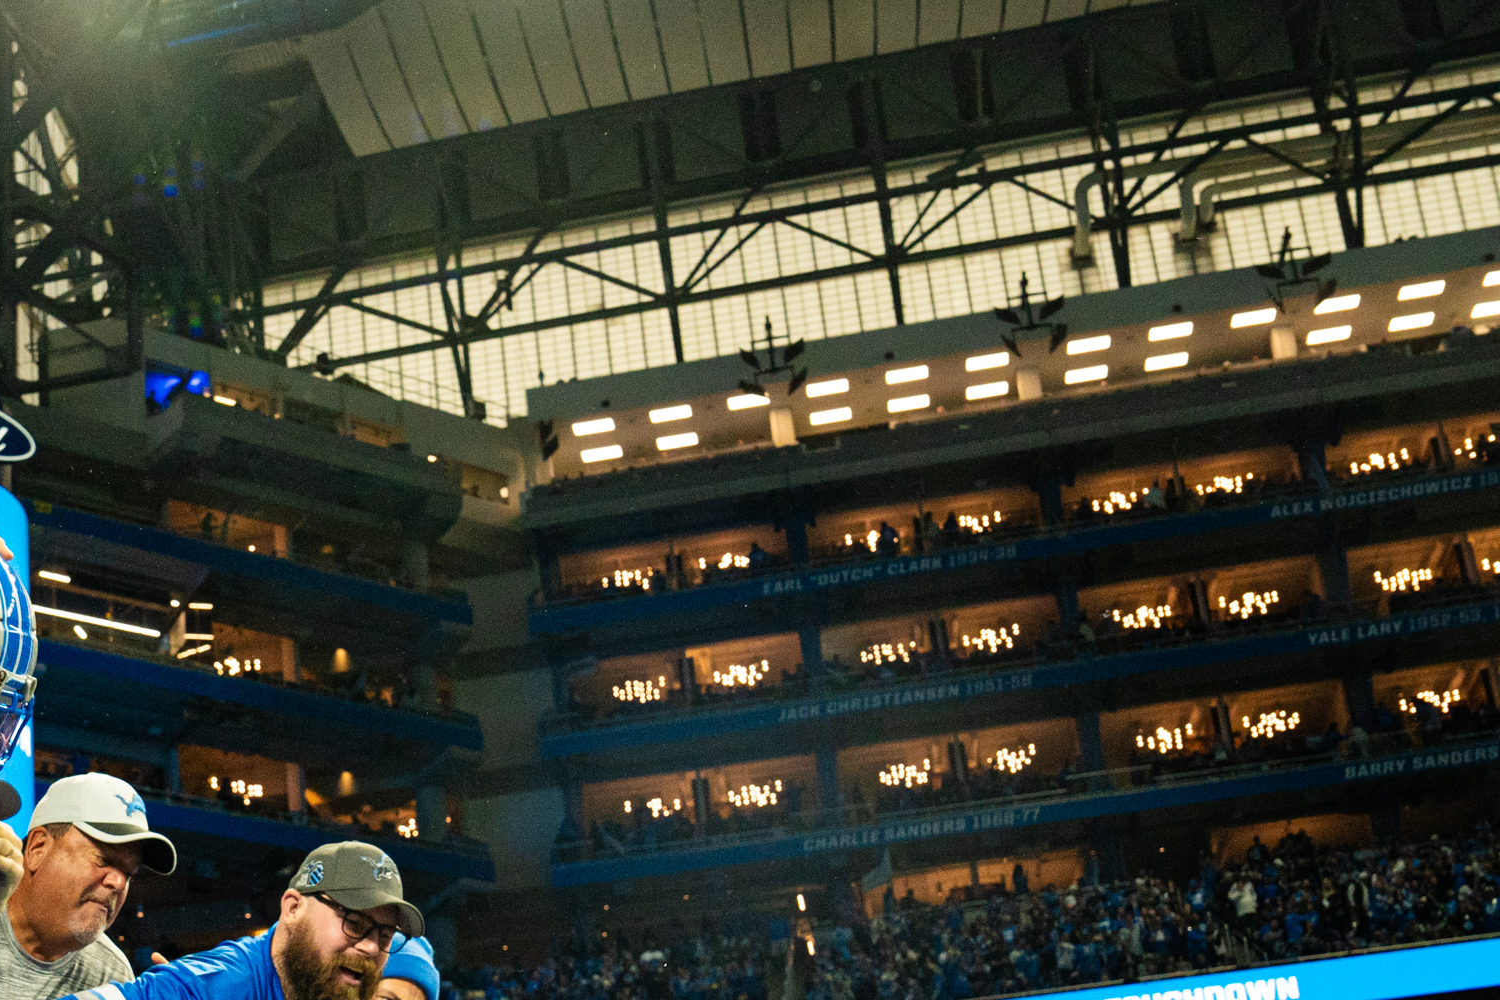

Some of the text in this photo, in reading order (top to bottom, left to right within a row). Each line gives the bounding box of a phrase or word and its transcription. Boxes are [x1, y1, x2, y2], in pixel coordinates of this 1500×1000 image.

[1271, 500, 1314, 518] ALEX
[763, 579, 803, 595] EARL
[887, 556, 942, 575] CLARK
[1308, 627, 1350, 646] YALE
[1357, 618, 1400, 640] LARY
[779, 703, 820, 721] JACK
[826, 685, 960, 713] CHRISTIANSEN
[1345, 745, 1500, 780] BARRY SANDERS
[803, 828, 879, 851] CHARLIE
[884, 816, 966, 842] SANDERS
